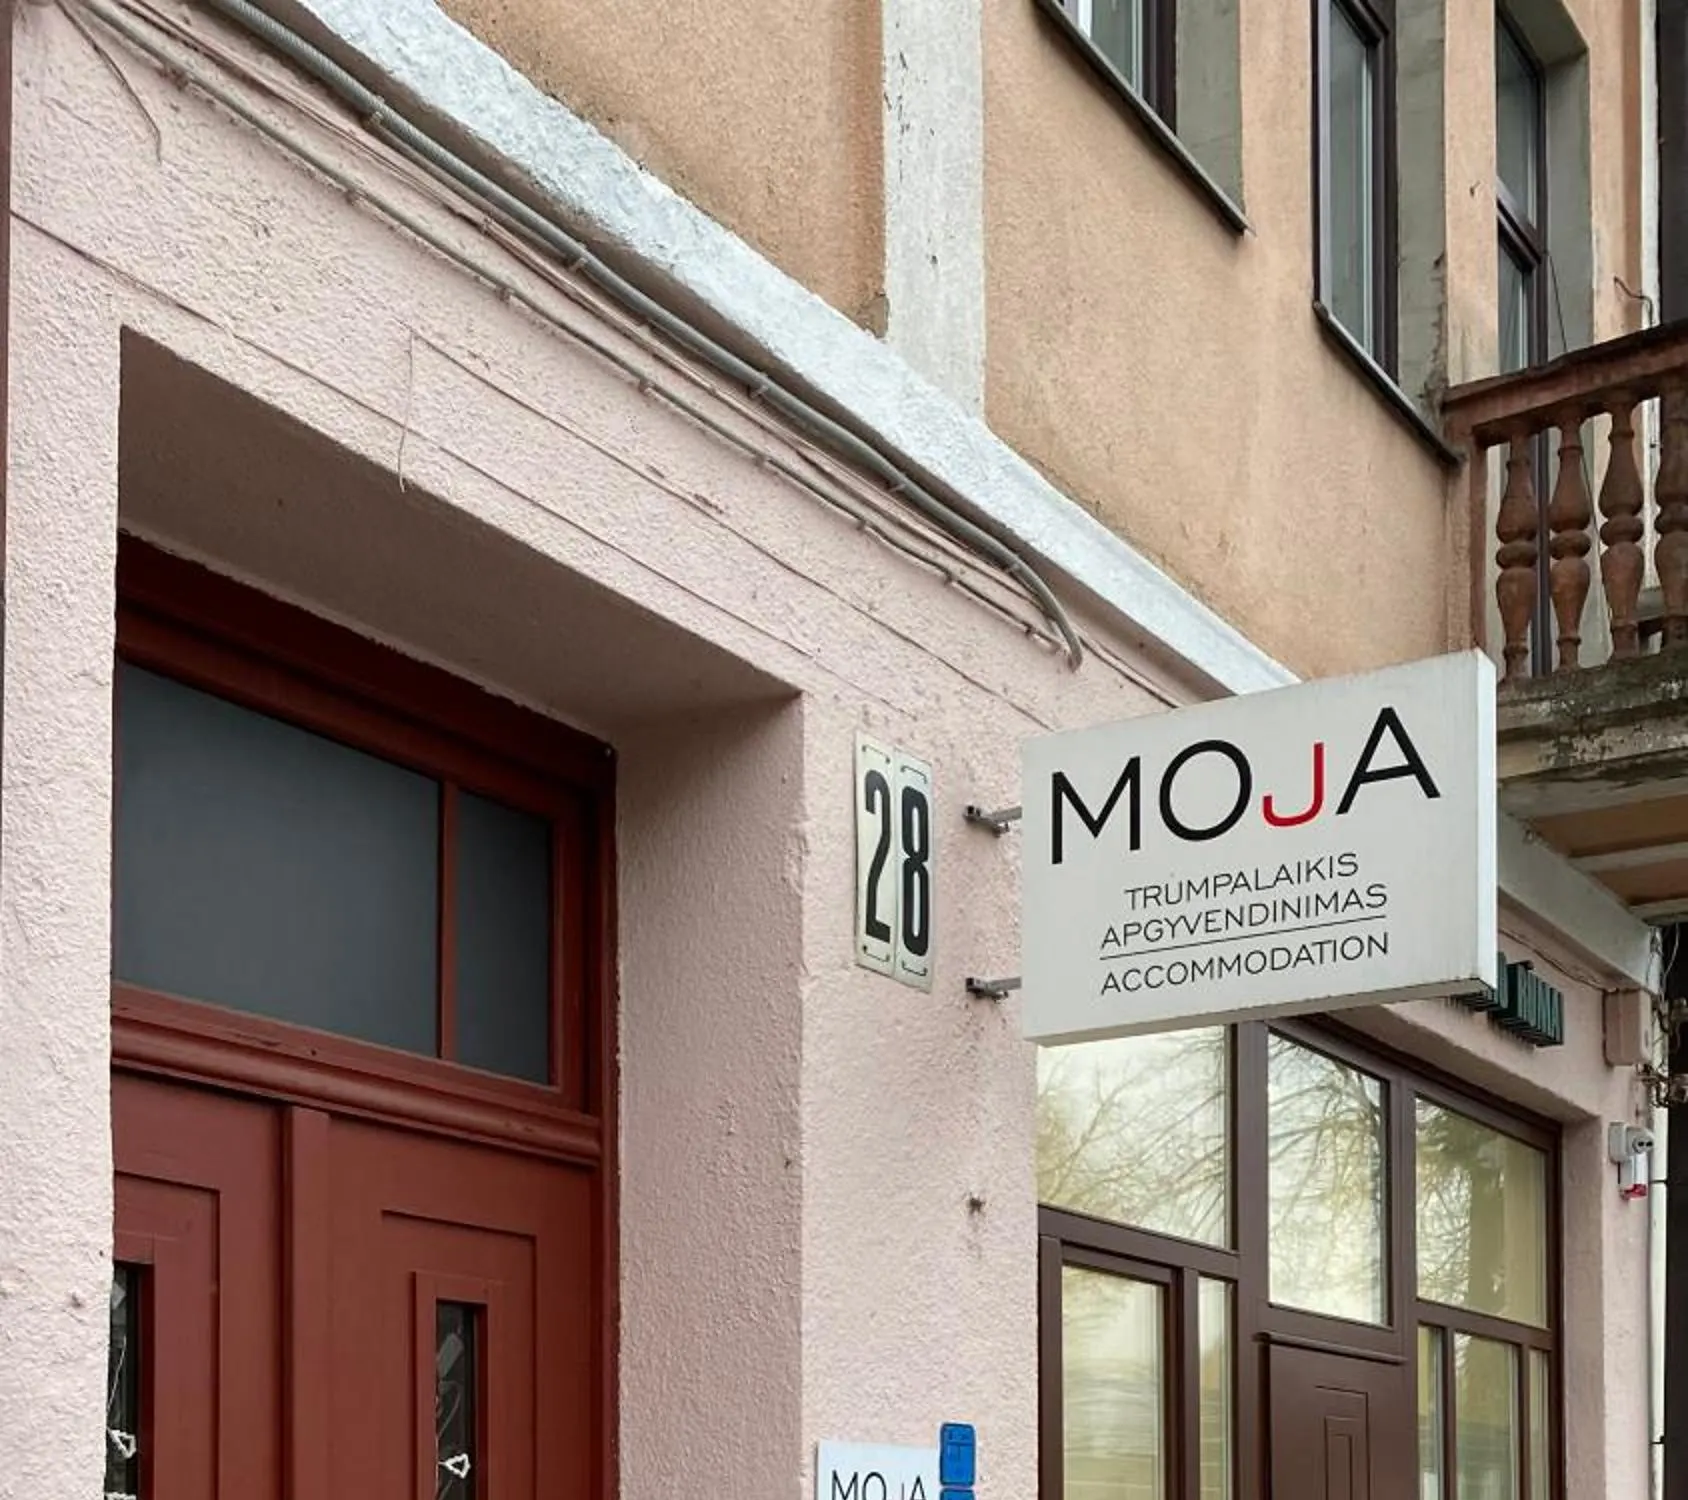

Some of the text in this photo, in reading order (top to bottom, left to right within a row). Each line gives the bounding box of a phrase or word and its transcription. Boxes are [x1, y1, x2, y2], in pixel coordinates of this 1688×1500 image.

[1051, 706, 1441, 865] MOJA
[864, 769, 930, 958] 28
[1124, 852, 1359, 910] TRUMPALAIKIS
[1101, 883, 1389, 951] APGYVENDINIMAS
[1101, 932, 1390, 996] ACCOMMODATION
